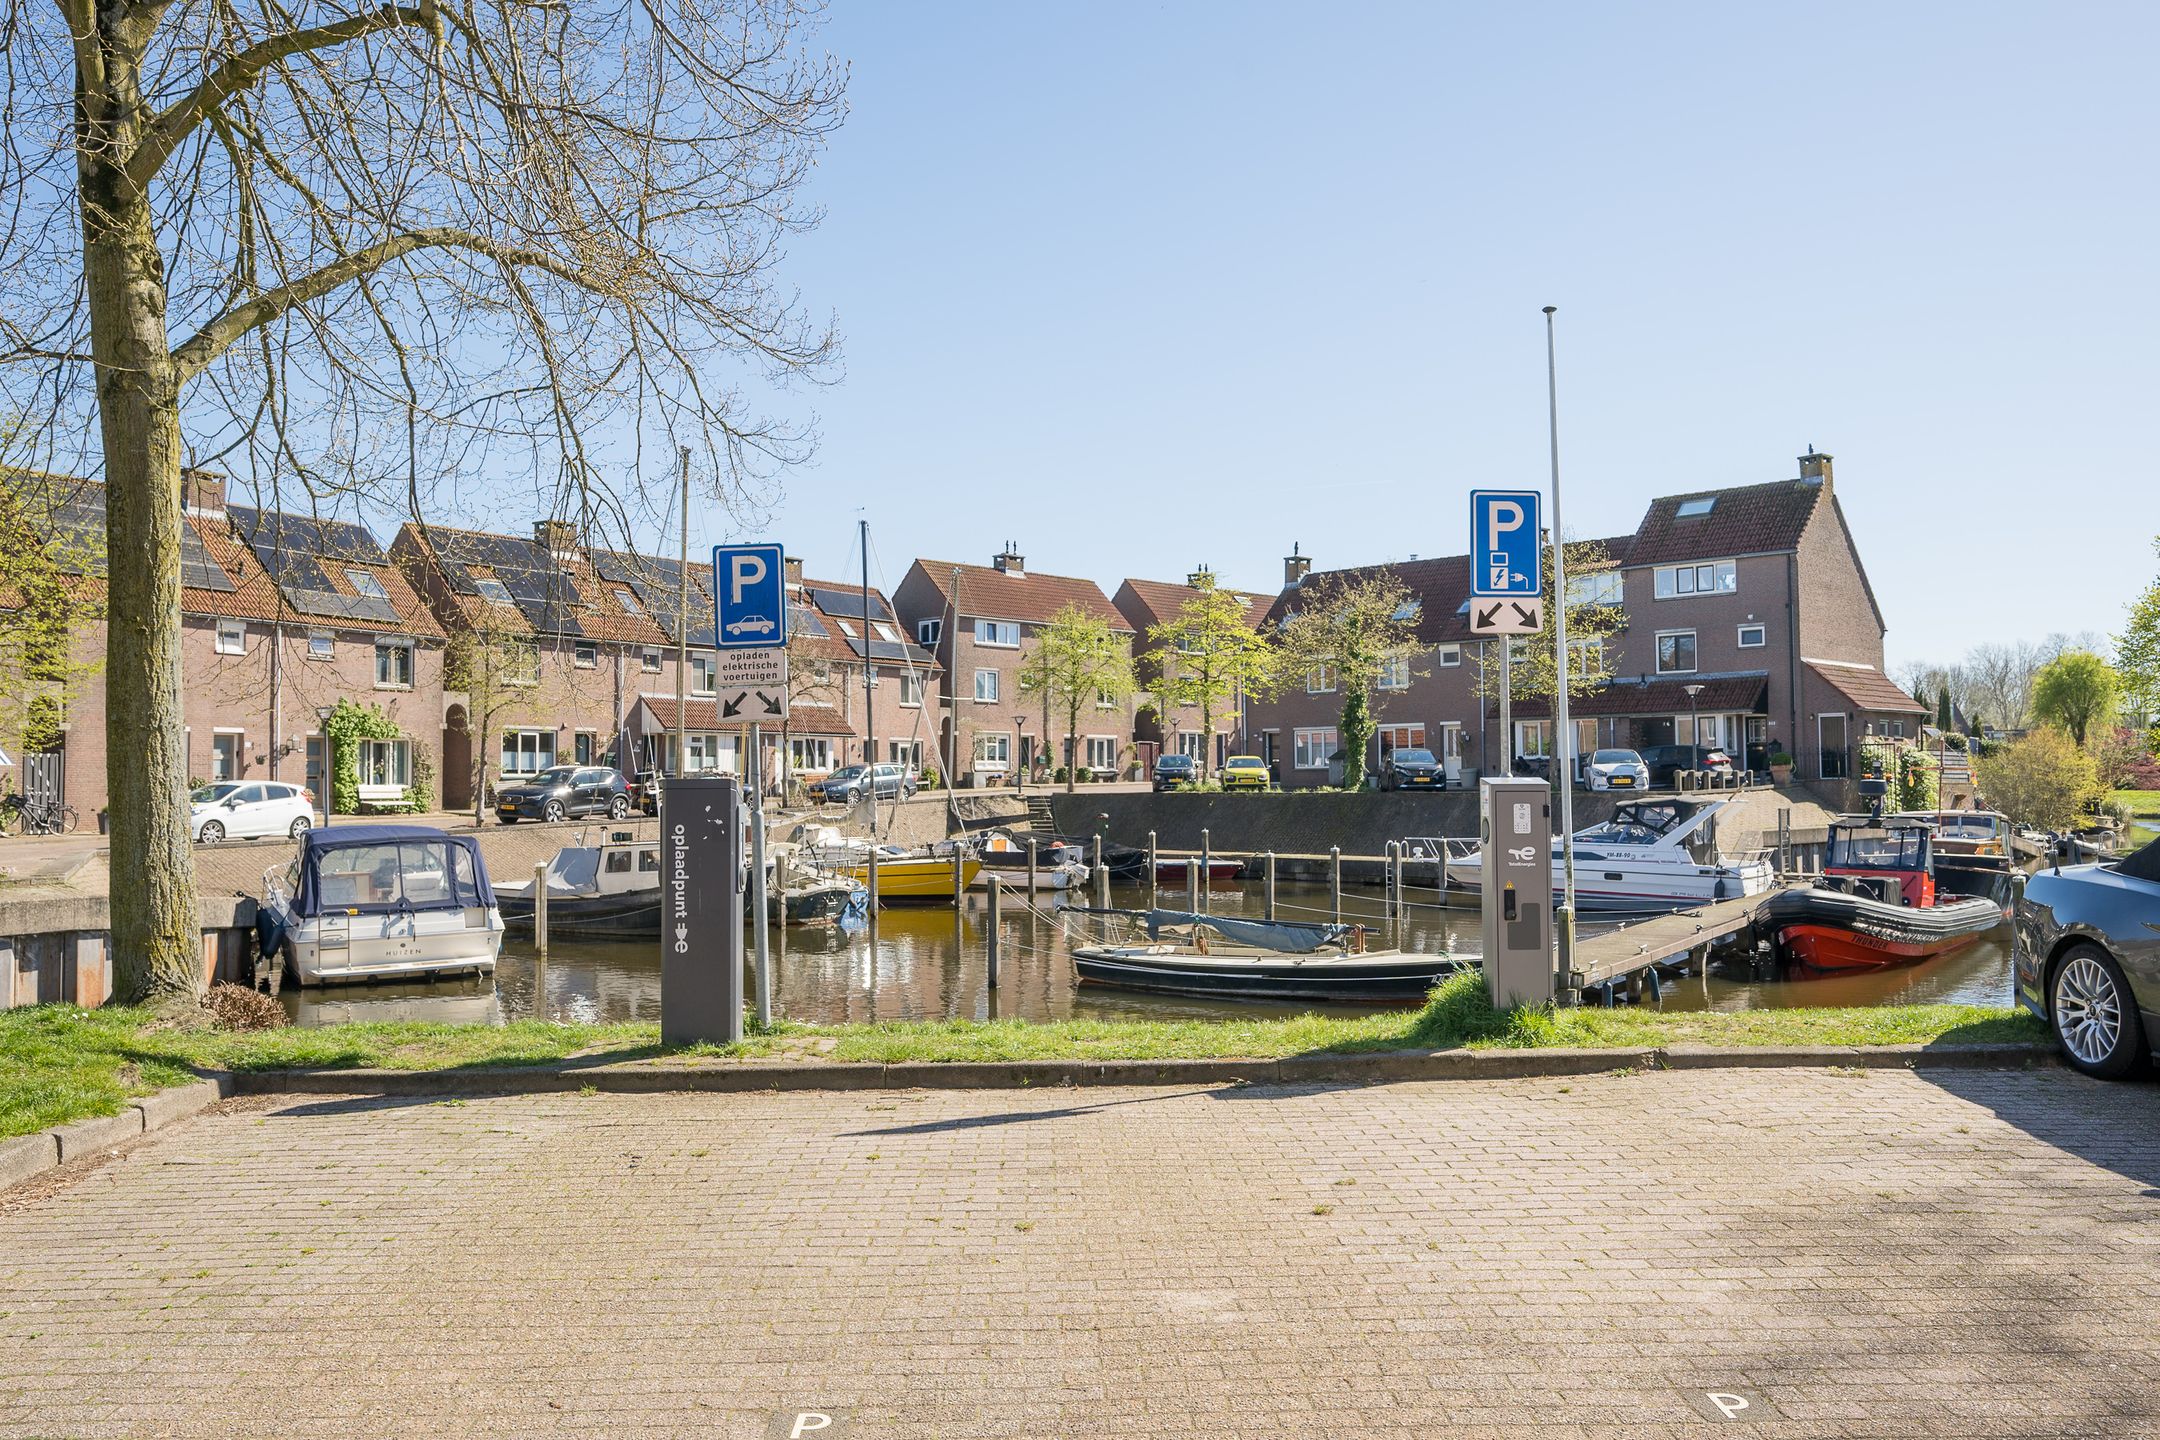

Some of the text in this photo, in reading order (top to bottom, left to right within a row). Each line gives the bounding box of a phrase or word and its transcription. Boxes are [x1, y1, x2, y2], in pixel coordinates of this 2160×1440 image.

[1489, 501, 1524, 551] P
[731, 555, 767, 603] P
[722, 661, 779, 671] elektrische
[730, 652, 770, 662] opladen
[723, 671, 778, 682] voertuigen
[671, 824, 690, 918] oplaadpunt
[385, 949, 422, 957] HUIZEN
[1705, 1392, 1750, 1419] P
[790, 1412, 832, 1439] P
